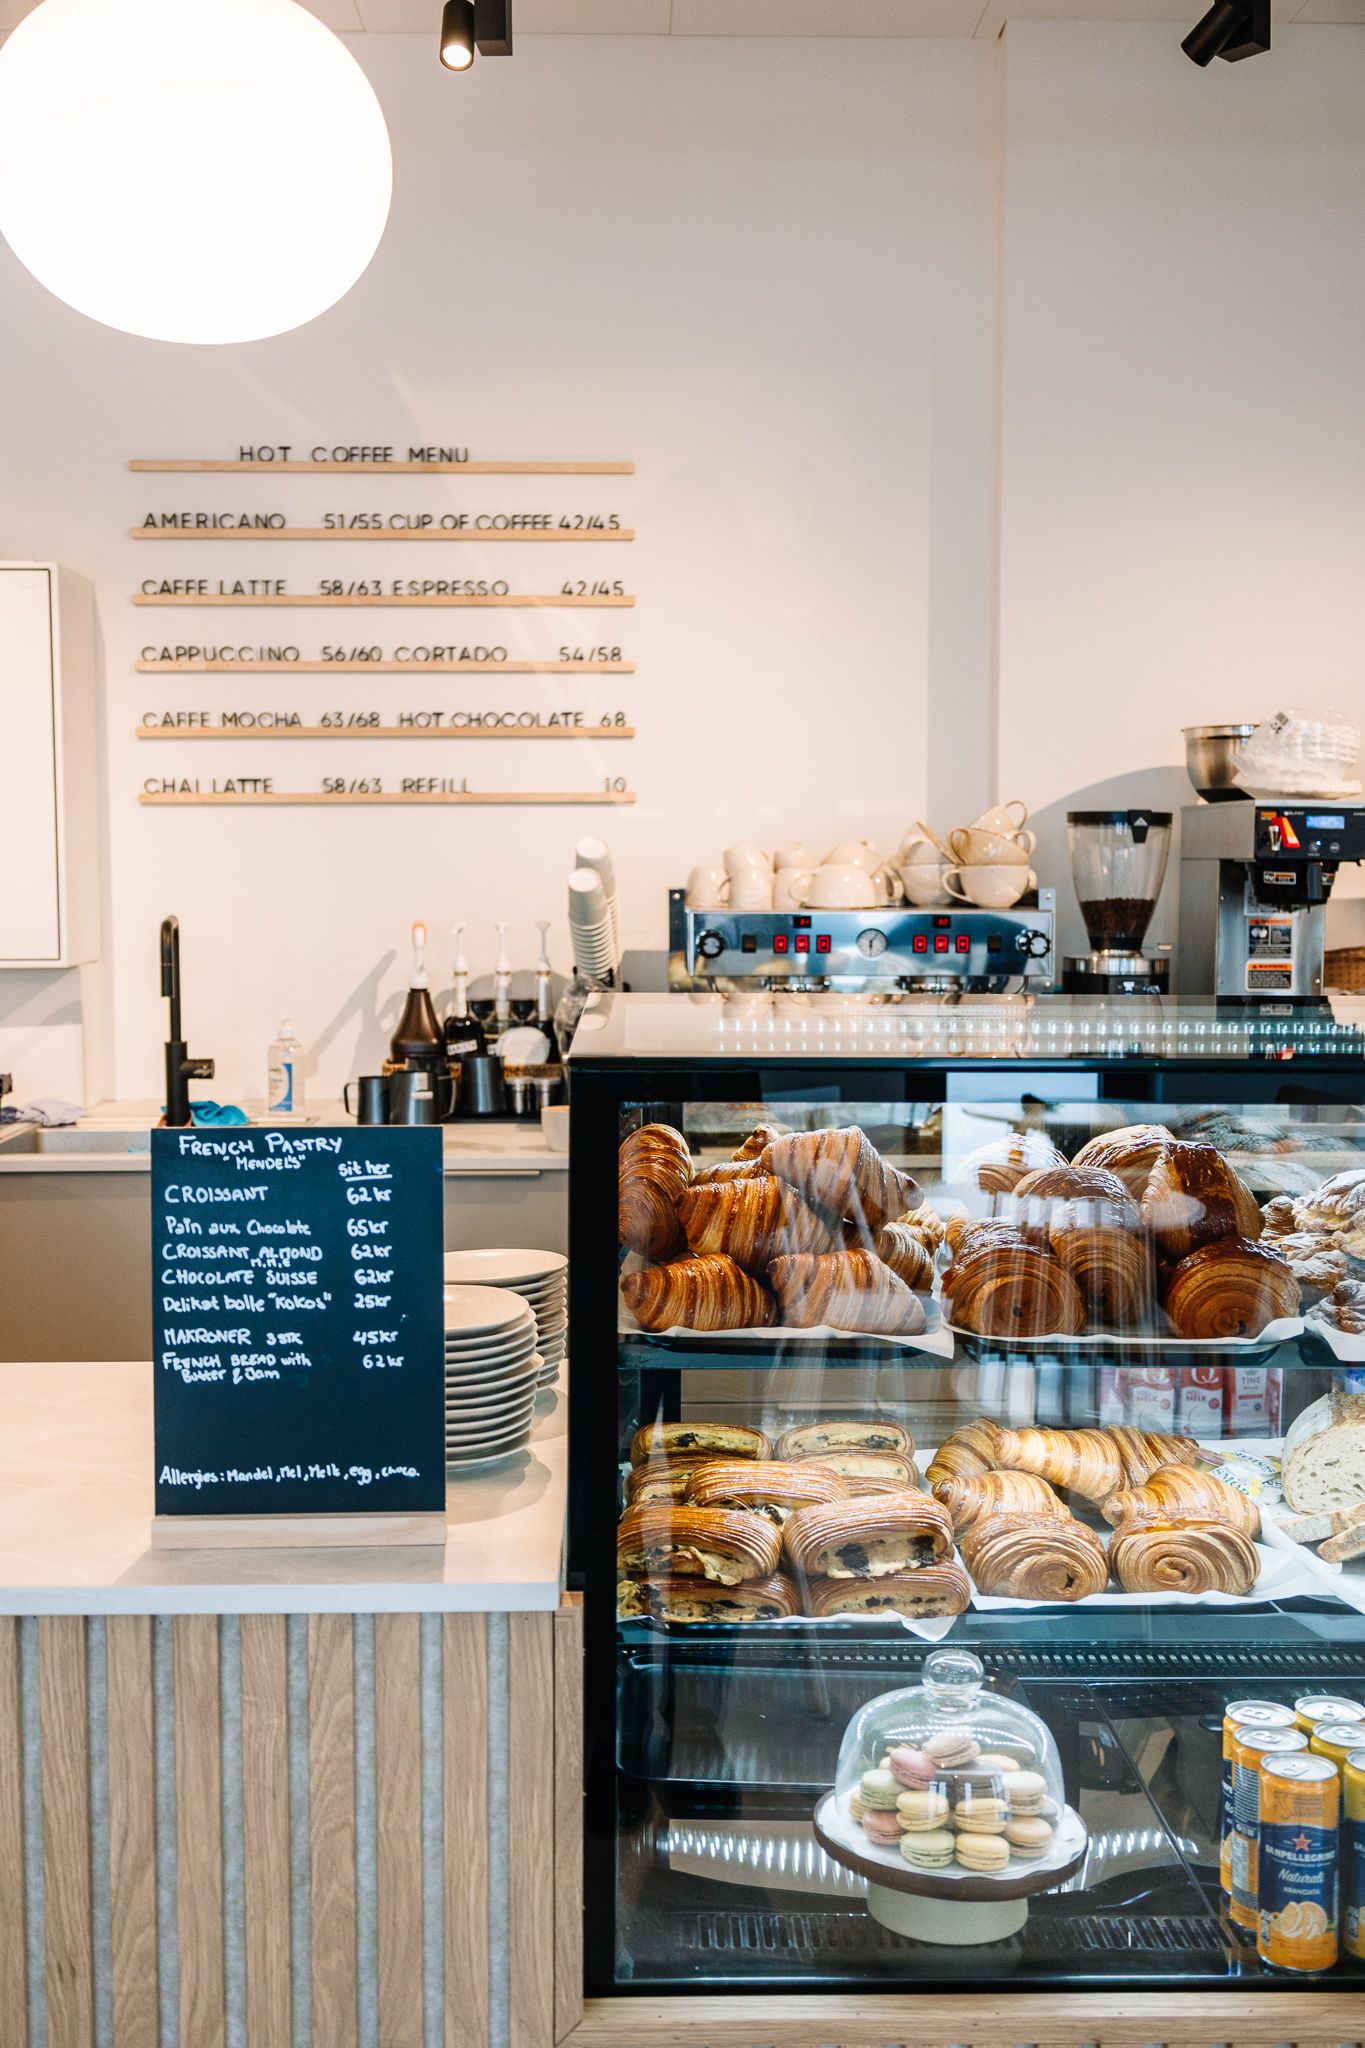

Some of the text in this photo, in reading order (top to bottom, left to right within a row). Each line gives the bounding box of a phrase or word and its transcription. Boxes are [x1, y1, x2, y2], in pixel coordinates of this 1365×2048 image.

[239, 446, 469, 462] HOT COFFEE MENU
[143, 513, 382, 530] AMERICANO 51/55
[389, 514, 620, 530] CUP OF COFFEE 42/45
[141, 579, 382, 596] CAFFE LATTE 58/63
[393, 580, 625, 596] ESPRESSO 42/45
[141, 646, 383, 662] CAPPUCCINO 56/60
[394, 646, 622, 662] CORTADO 54/58
[142, 712, 380, 728] CAFFE MOCHA 63/68
[400, 712, 626, 728] HOT CHOCOLATE 68
[143, 778, 382, 794] CHAI LATTE 58/63
[402, 778, 626, 794] REFILL 10
[179, 1132, 342, 1156] FRENCH PASTRY
[338, 1160, 391, 1177] sit her
[164, 1185, 269, 1204] CROISSANT
[208, 1222, 242, 1235] aux
[162, 1243, 250, 1261] CROISSANT
[258, 1246, 323, 1261] ALMOND
[161, 1269, 255, 1285] CHOCOLATE
[266, 1270, 318, 1285] SUISSE
[163, 1295, 220, 1312] Delikat
[224, 1294, 265, 1313] bolle
[164, 1328, 252, 1345] MAKRONER
[162, 1352, 221, 1371] FRENCH
[230, 1354, 277, 1368] BREAD
[280, 1352, 312, 1367] with
[181, 1369, 226, 1385] Butter
[244, 1368, 280, 1382] Jam
